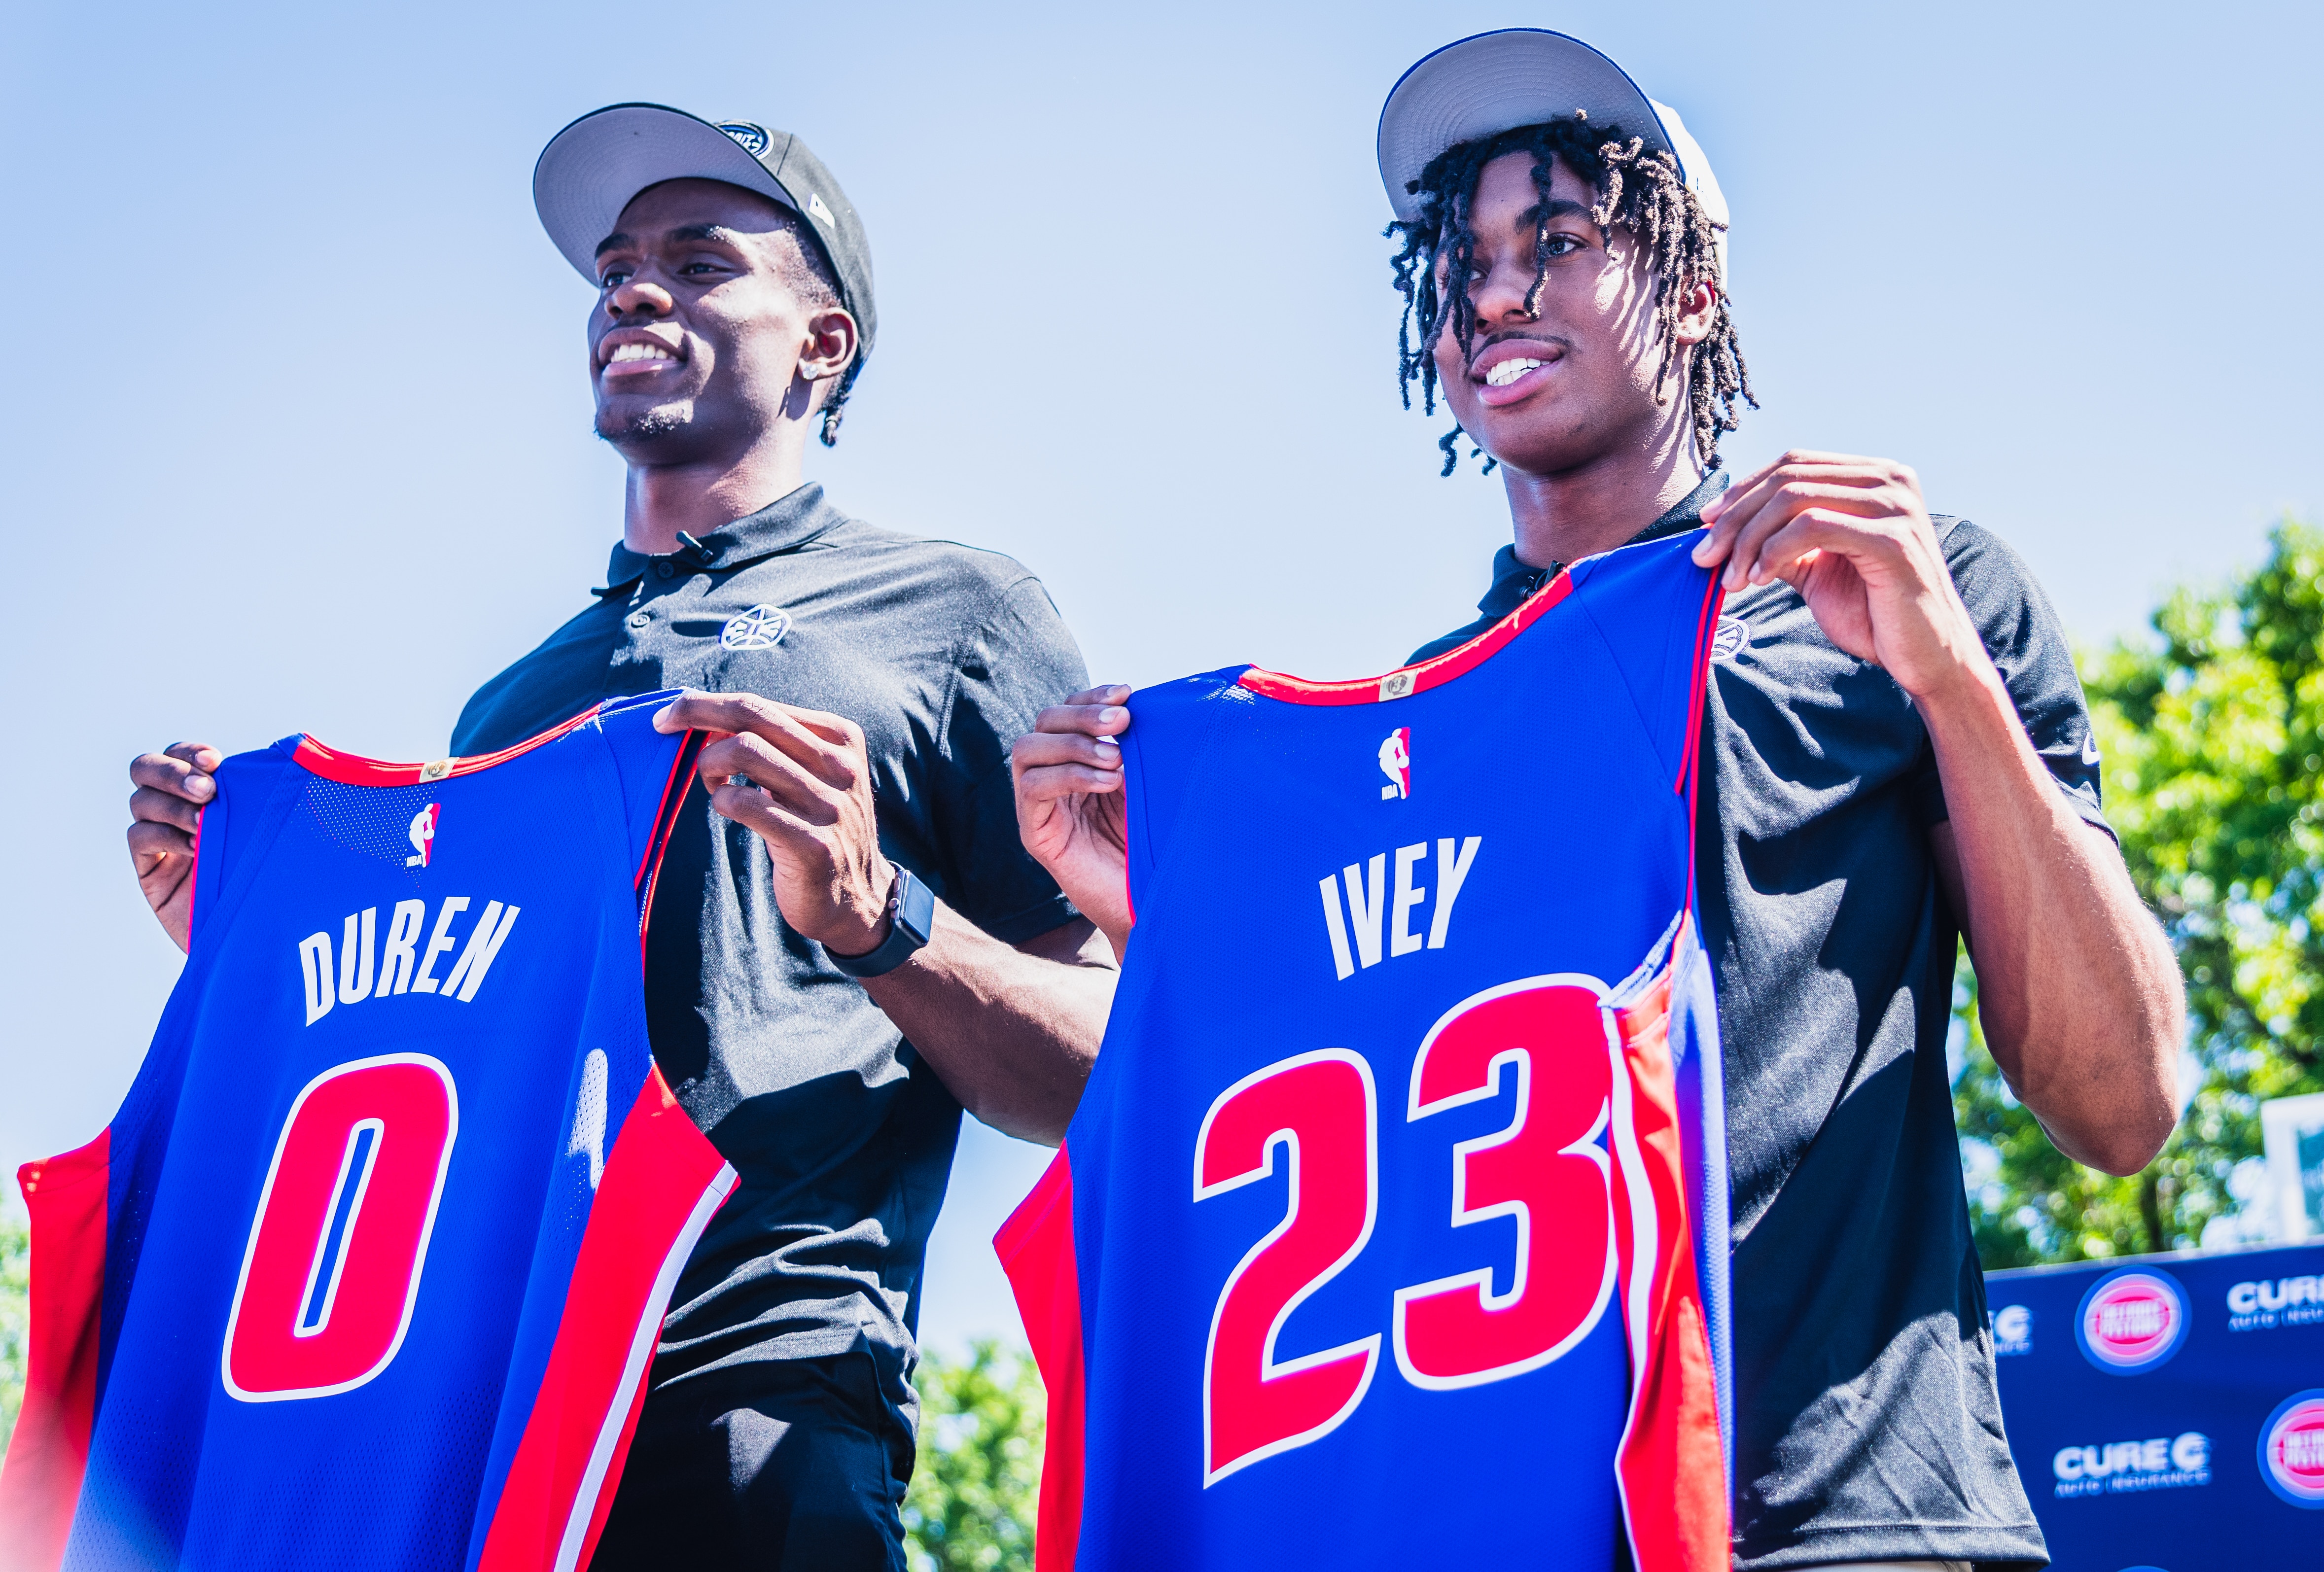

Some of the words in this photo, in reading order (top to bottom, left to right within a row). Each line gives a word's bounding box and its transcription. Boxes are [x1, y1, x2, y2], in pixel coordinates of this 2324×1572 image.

[1381, 784, 1398, 801] NBA
[406, 854, 422, 868] NBA
[1318, 836, 1482, 981] IVEY
[298, 896, 521, 1027] DUREN
[221, 1051, 459, 1403] 0
[1193, 972, 1619, 1490] 23
[2226, 1273, 2324, 1315] CUR
[2053, 1437, 2170, 1481] CURE
